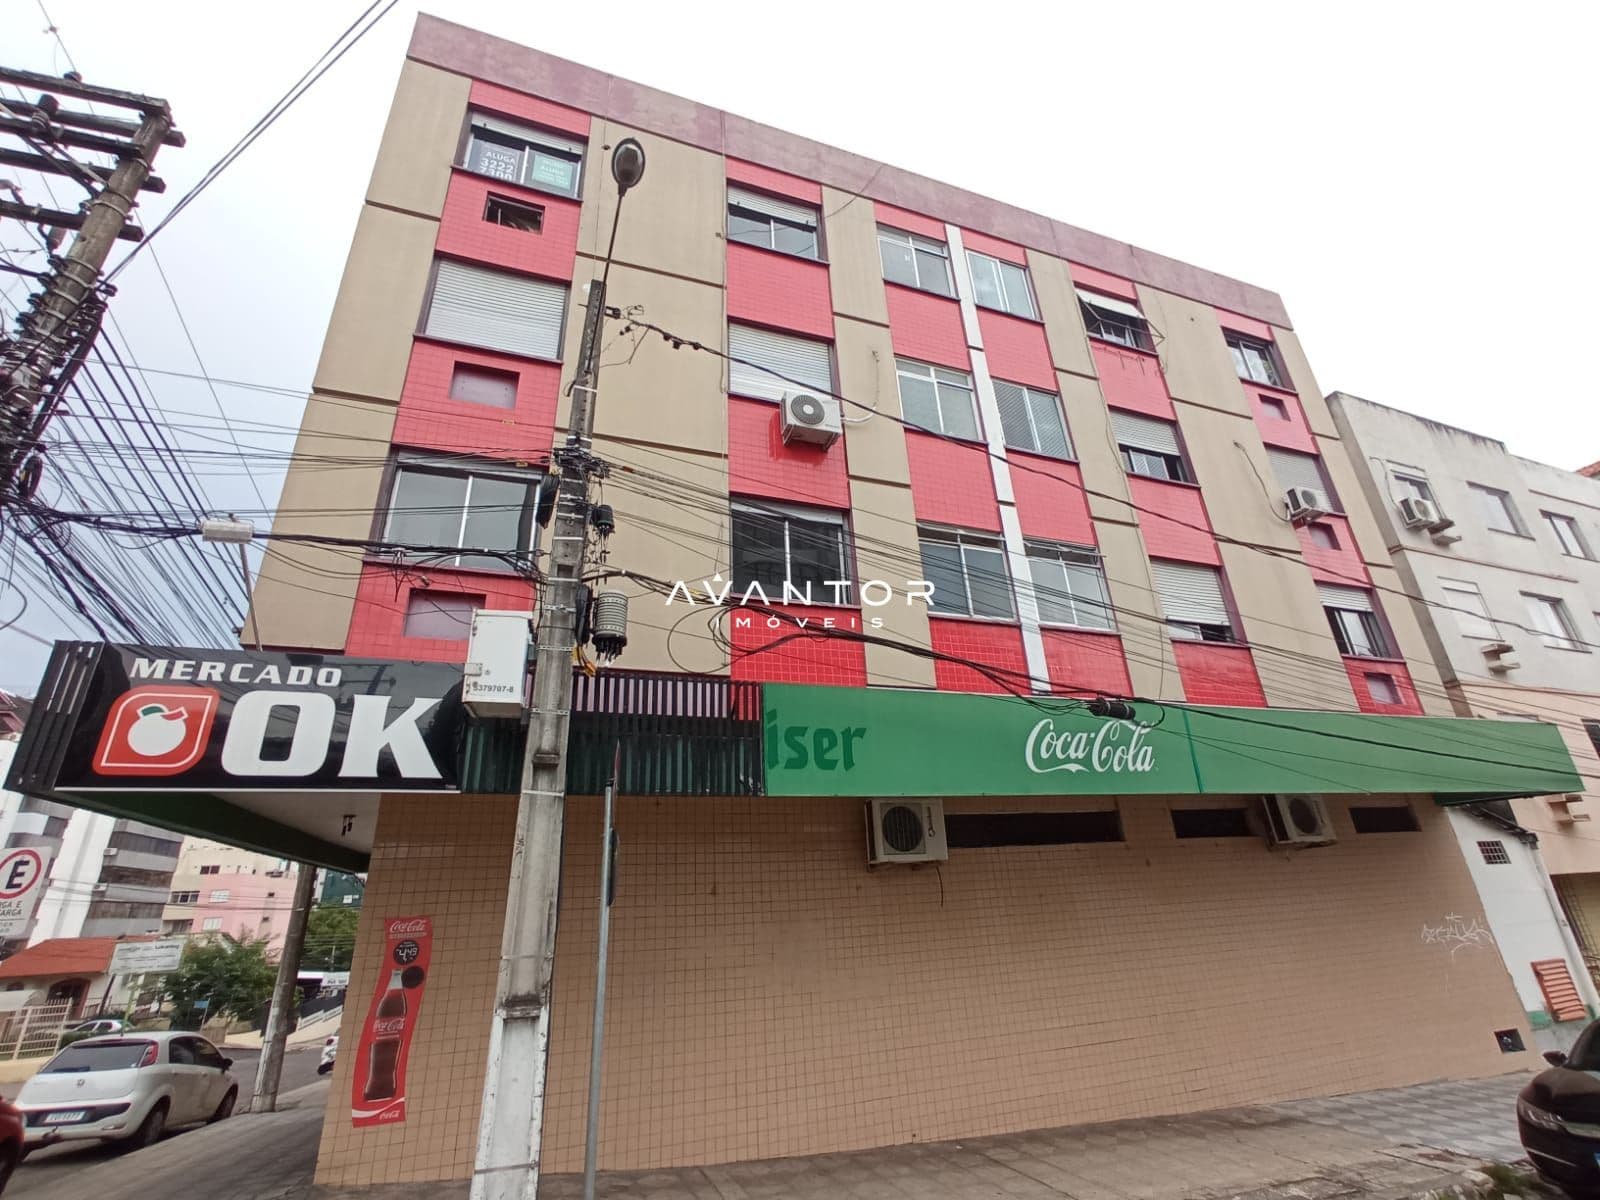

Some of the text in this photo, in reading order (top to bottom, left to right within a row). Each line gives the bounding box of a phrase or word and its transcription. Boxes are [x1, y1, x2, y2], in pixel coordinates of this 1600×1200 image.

[481, 158, 514, 173] 3222
[486, 151, 516, 165] ALUGA
[129, 657, 342, 687] MERCADO
[221, 690, 443, 779] OK
[766, 708, 867, 772] iser
[1025, 718, 1156, 773] Coca-Cola
[5, 860, 30, 889] E
